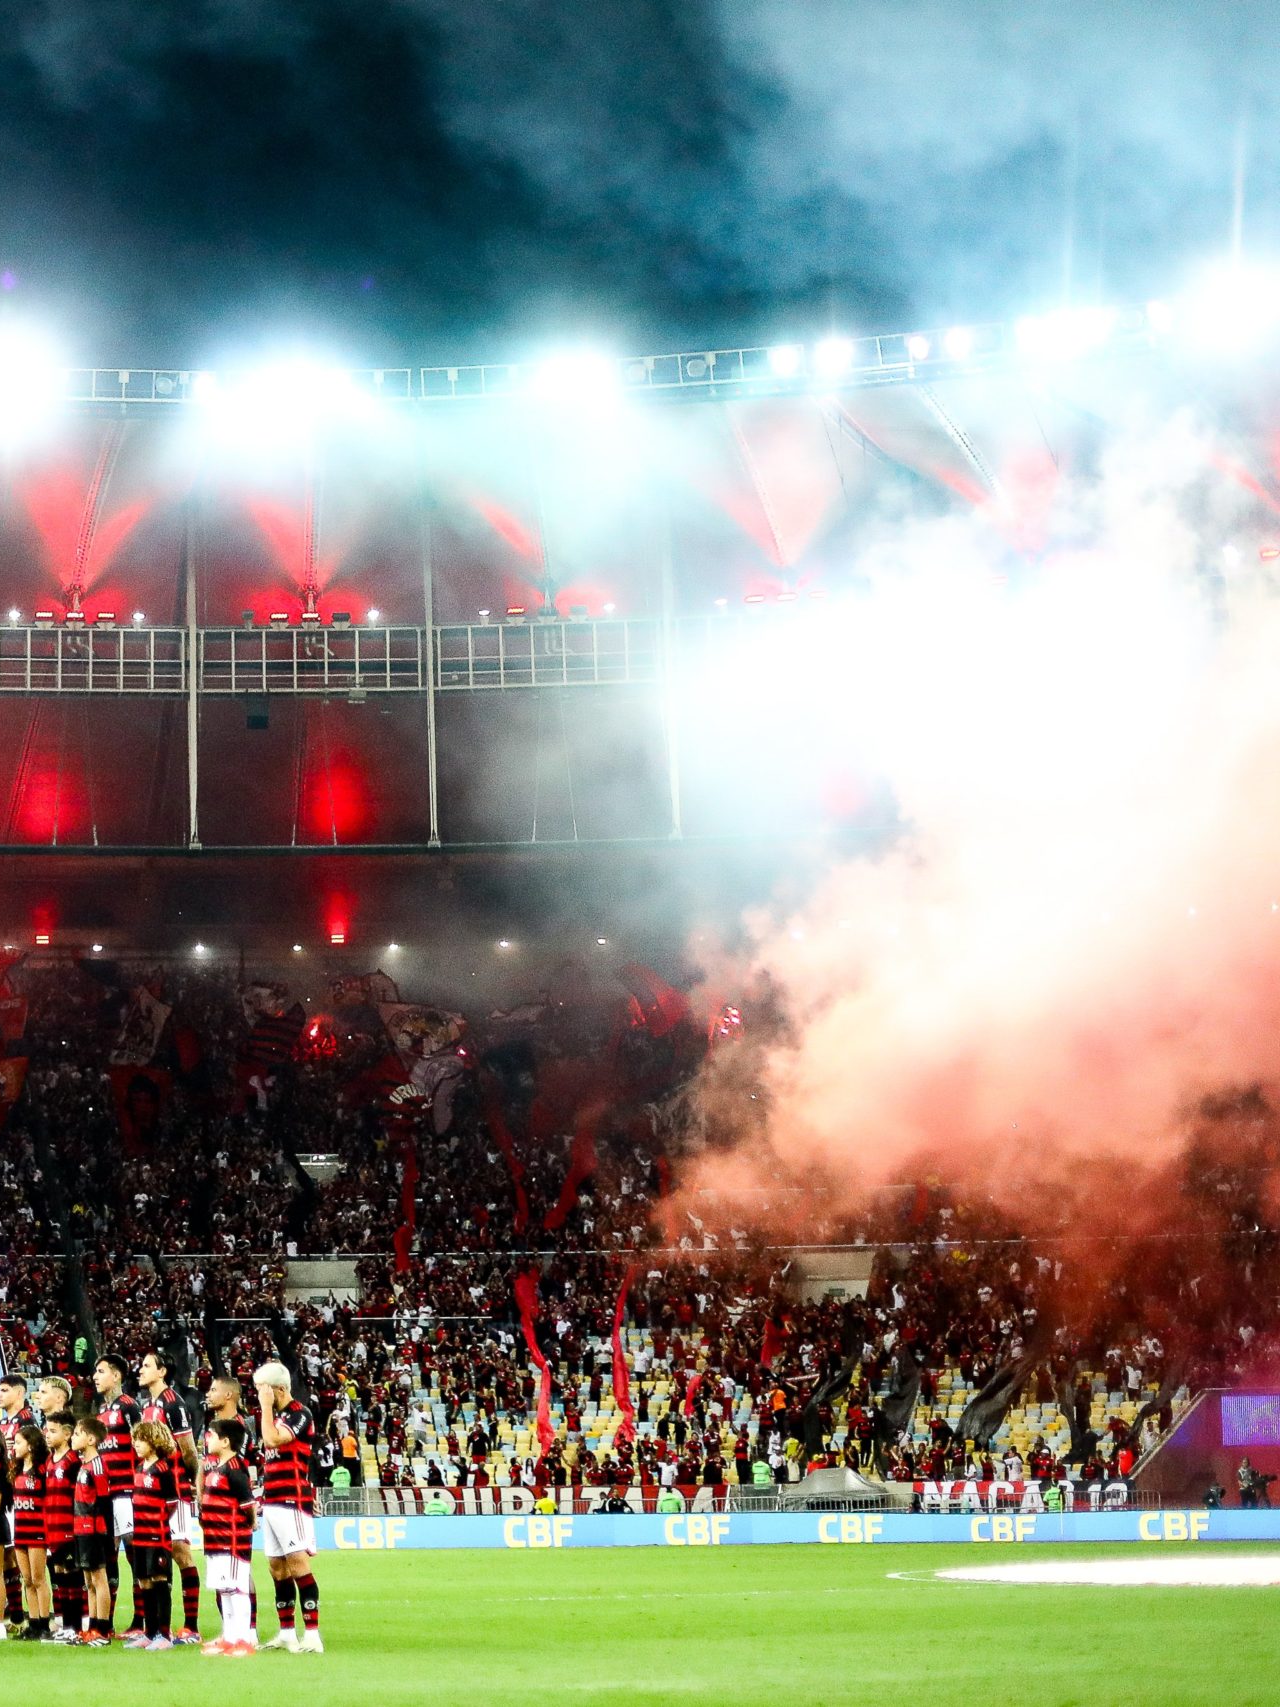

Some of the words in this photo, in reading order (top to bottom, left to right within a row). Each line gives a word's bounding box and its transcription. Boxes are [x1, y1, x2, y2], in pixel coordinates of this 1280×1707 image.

[334, 1518, 408, 1549] CBF
[503, 1517, 574, 1548] CBF
[664, 1515, 731, 1545] CBF
[818, 1514, 884, 1543] CBF
[971, 1514, 1037, 1542] CBF
[1139, 1511, 1210, 1541] CBF
